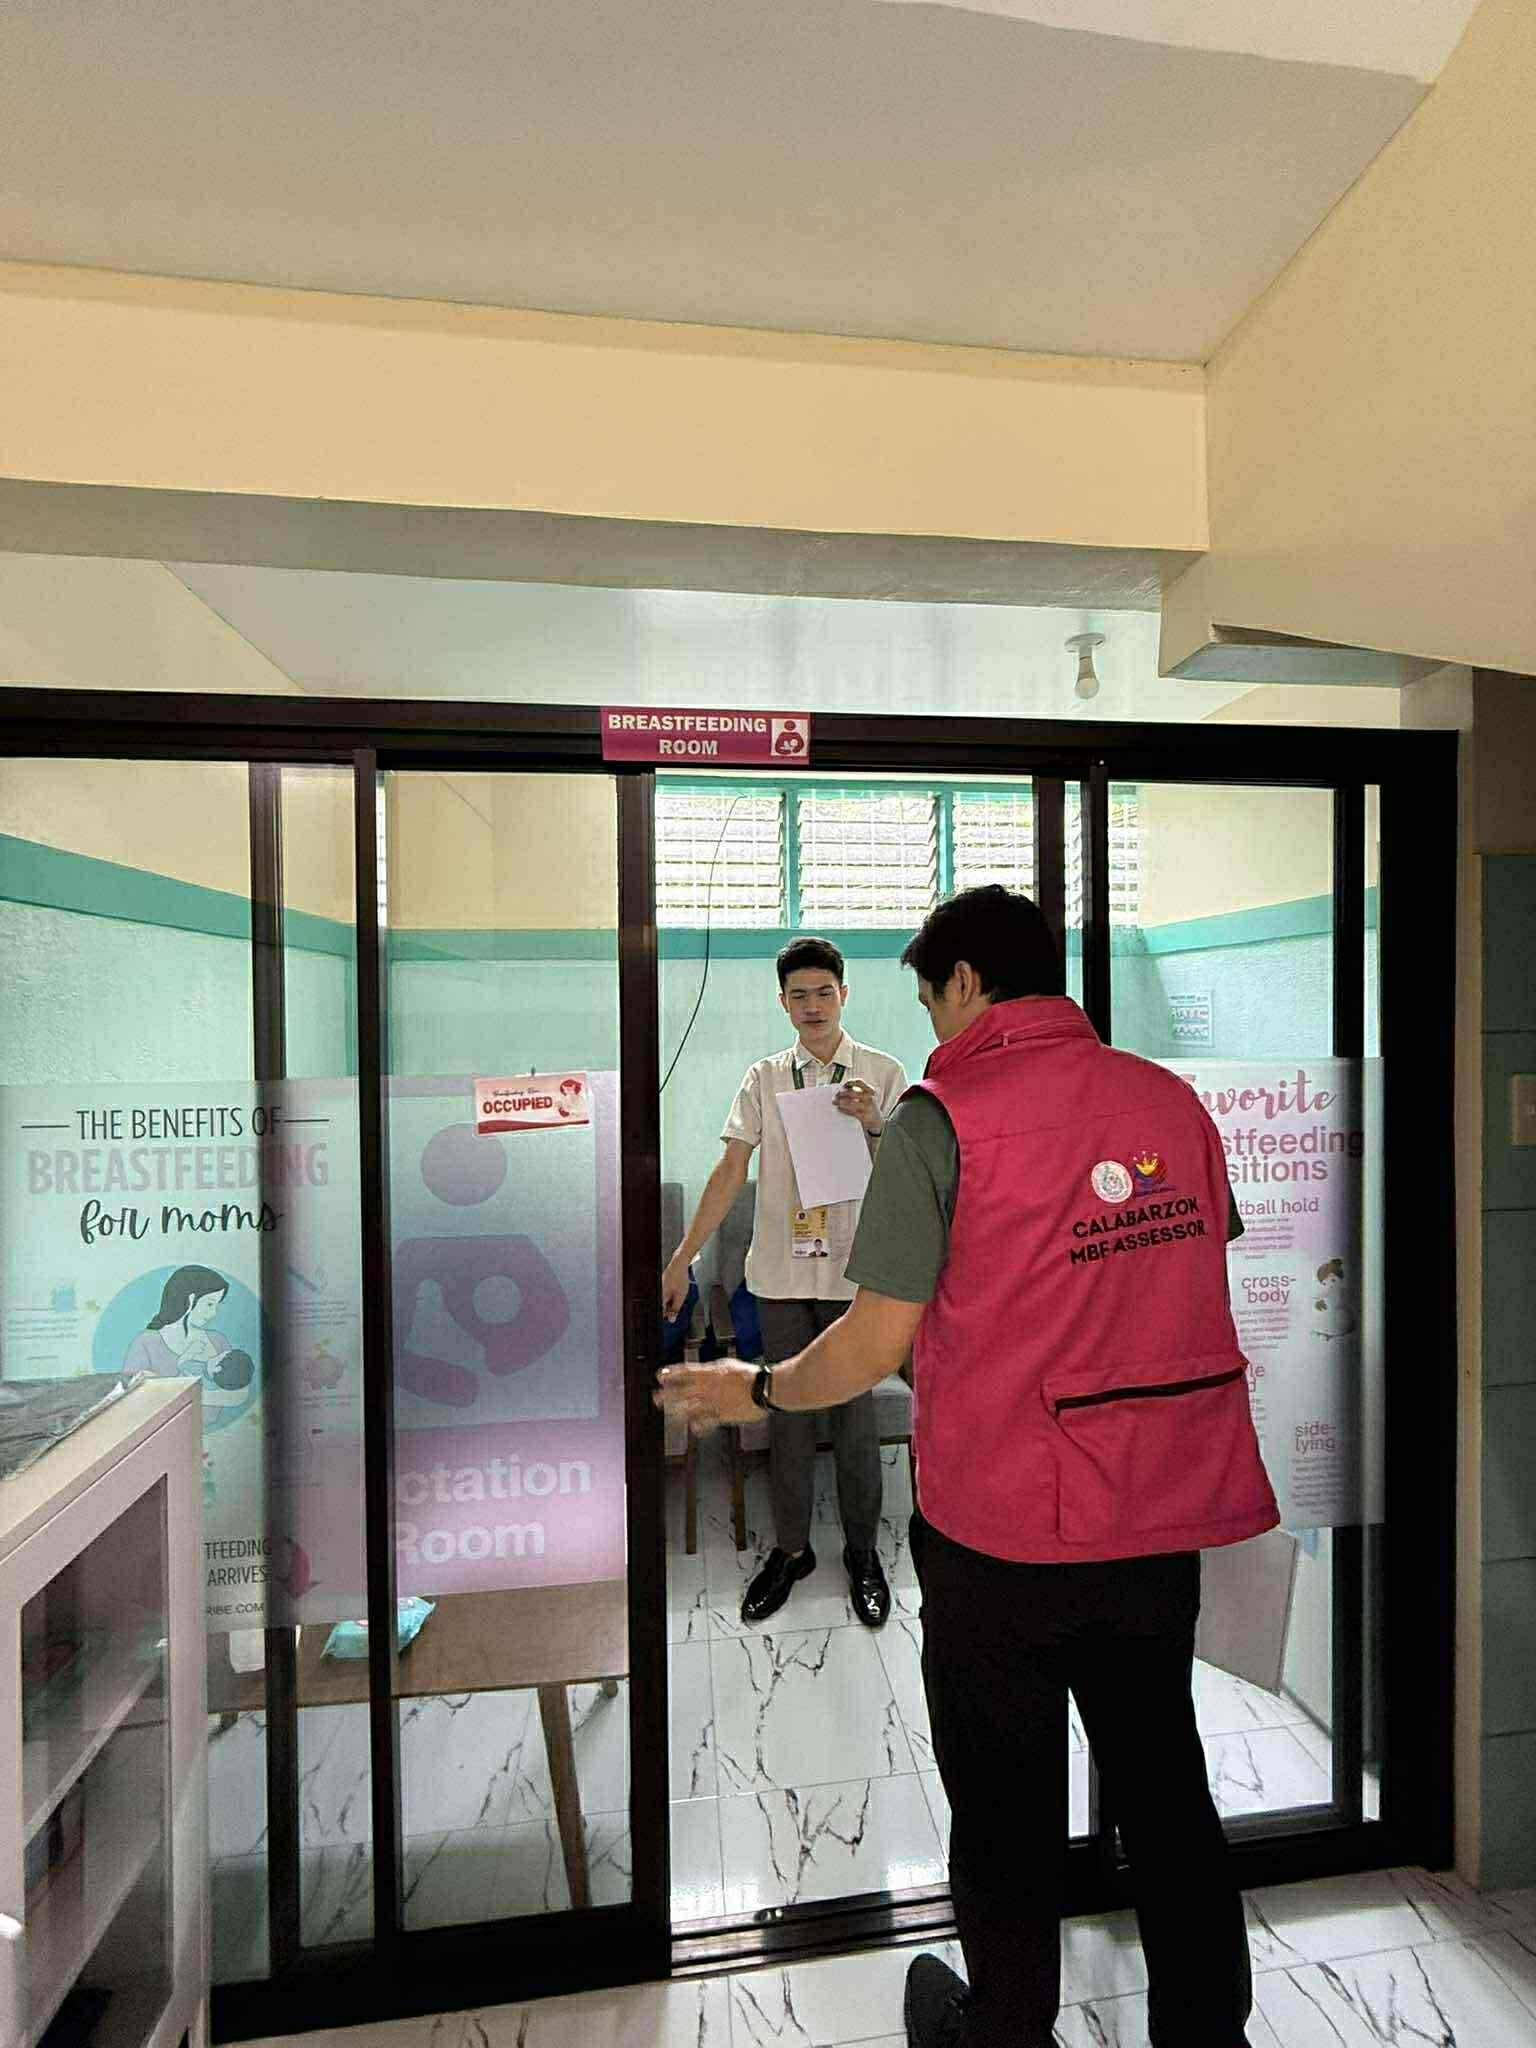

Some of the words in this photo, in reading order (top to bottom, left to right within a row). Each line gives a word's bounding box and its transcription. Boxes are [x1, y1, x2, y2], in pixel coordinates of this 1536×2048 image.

[608, 714, 767, 732] BREASTFEEDING
[659, 739, 718, 755] ROOM
[483, 1096, 553, 1114] OCCUPIED
[76, 1110, 122, 1140] THE
[132, 1107, 243, 1138] BENEFITS
[252, 1106, 282, 1136] OF
[27, 1143, 329, 1194] BREASTFEEDING
[1281, 1197, 1319, 1213] hold
[80, 1199, 150, 1244] for
[161, 1201, 284, 1234] moms
[1072, 1197, 1200, 1239] CALABARZON
[1070, 1239, 1110, 1265] MBF
[1113, 1219, 1206, 1254] ASSESSOR
[1241, 1275, 1296, 1289] cross-
[1248, 1287, 1289, 1304] body
[207, 1565, 272, 1587] ARRIVES
